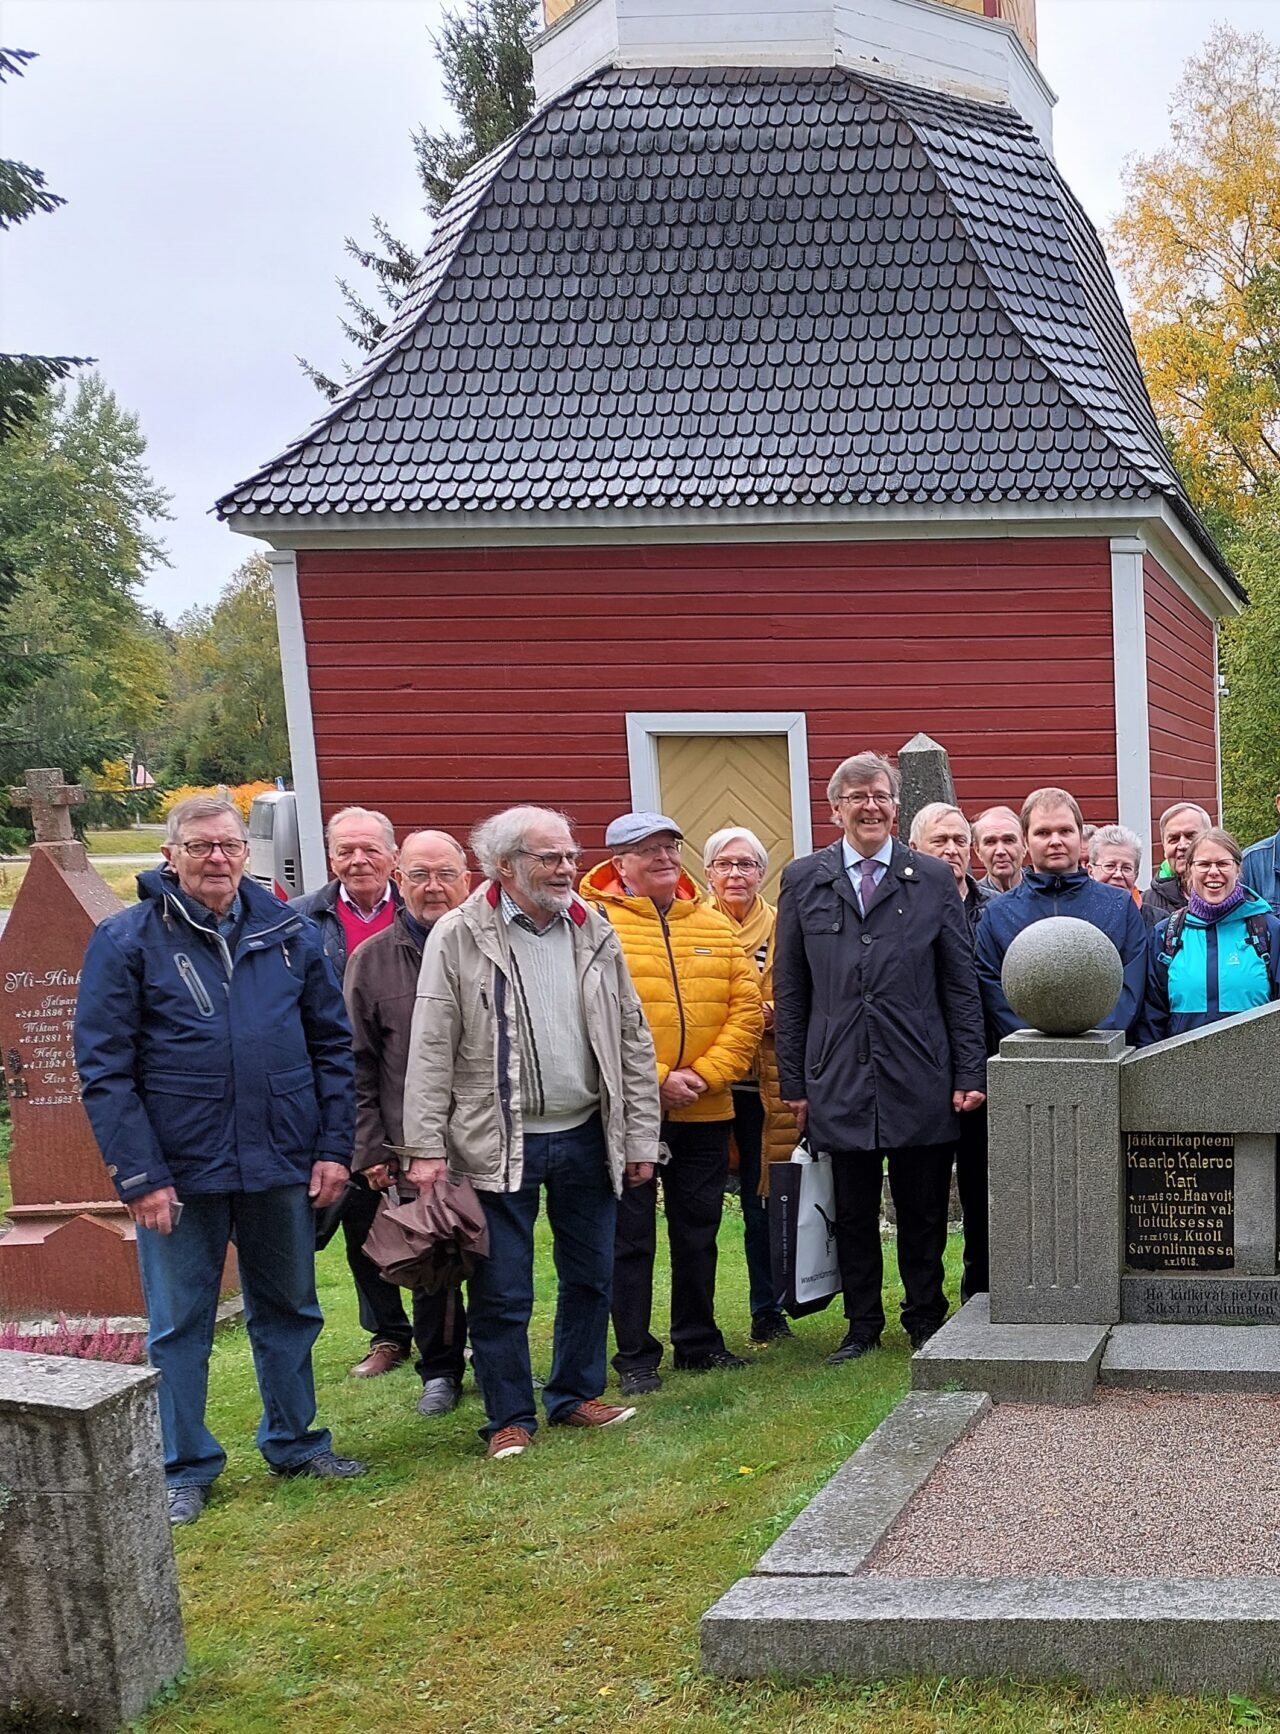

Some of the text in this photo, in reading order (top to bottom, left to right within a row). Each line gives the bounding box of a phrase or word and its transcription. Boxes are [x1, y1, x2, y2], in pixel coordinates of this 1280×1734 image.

[1127, 1134, 1234, 1150] Jääkärikapteeni
[1127, 1151, 1233, 1169] Kaarlo Kalervo
[1164, 1170, 1199, 1188] Kari
[1183, 1189, 1234, 1202] Haavoit-
[1130, 1203, 1234, 1219] tui Viipurin val-
[1138, 1215, 1224, 1228] loituksessa
[1185, 1230, 1222, 1242] Kuoli
[1128, 1243, 1234, 1256] Savonlinnassa
